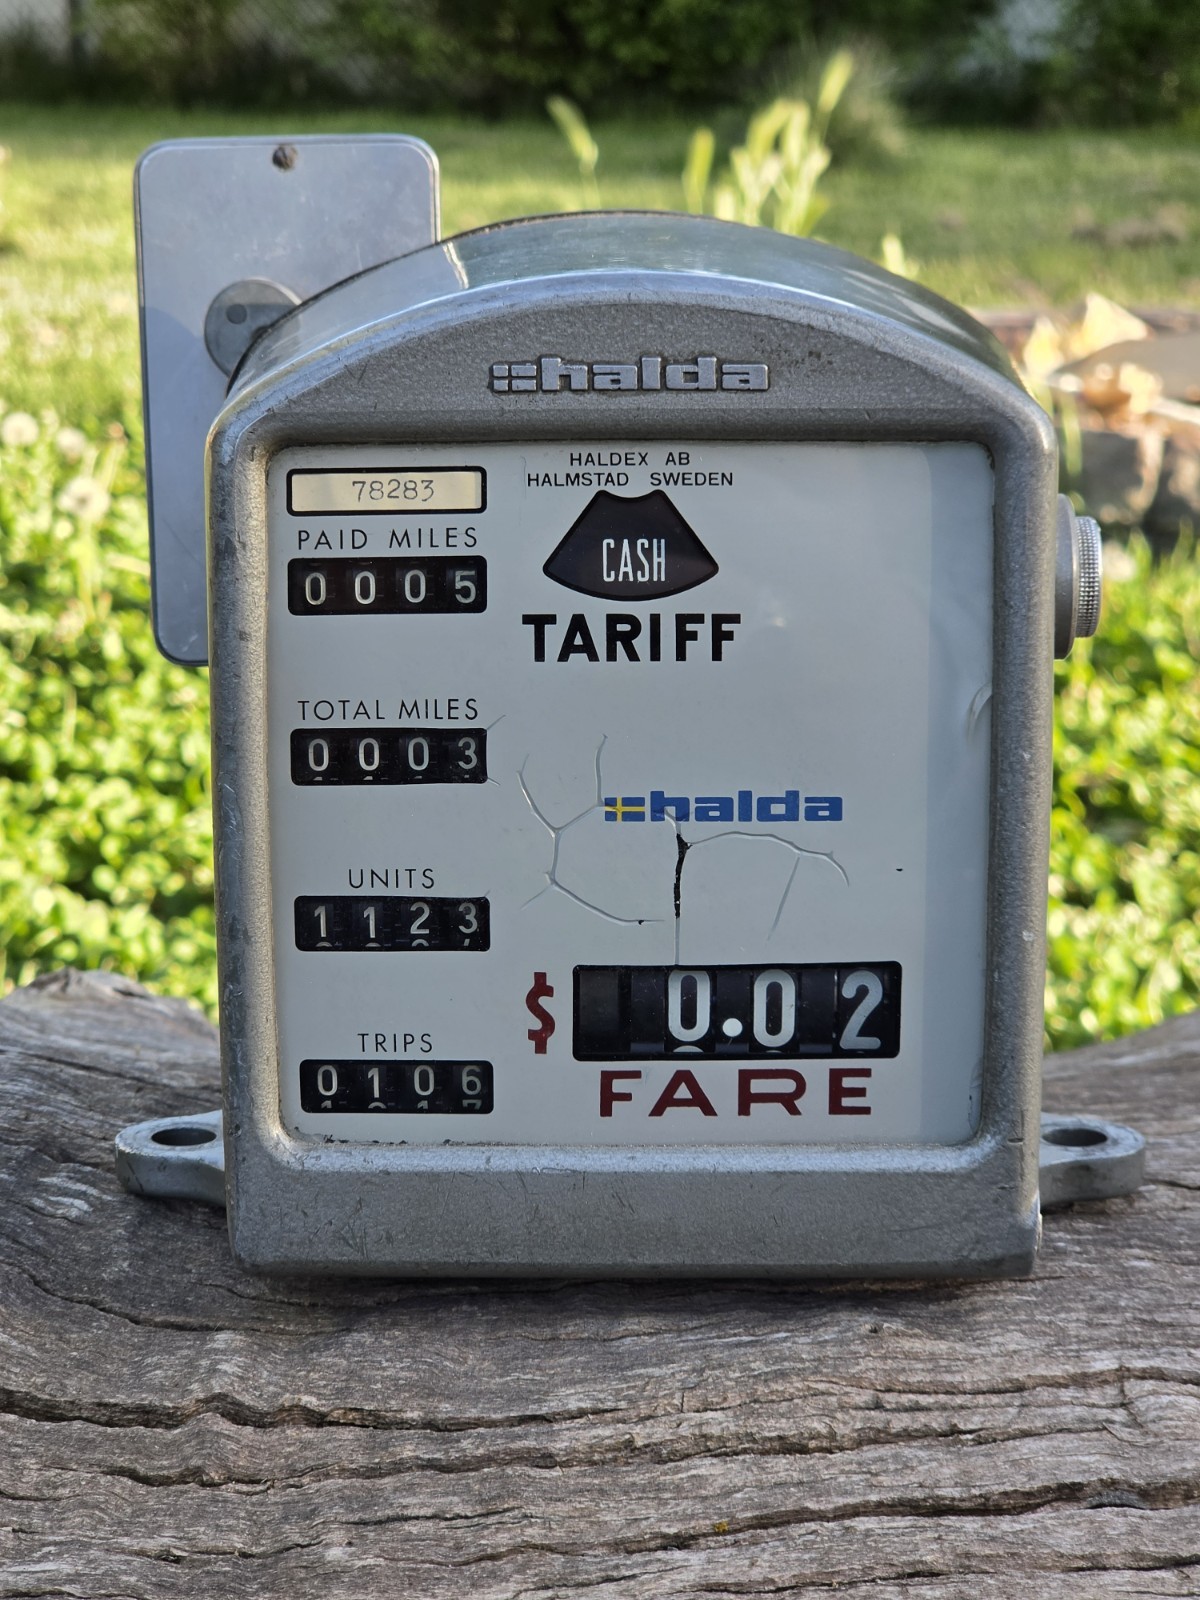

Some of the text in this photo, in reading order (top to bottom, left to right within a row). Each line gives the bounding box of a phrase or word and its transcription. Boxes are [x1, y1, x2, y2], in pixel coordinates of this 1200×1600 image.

[541, 356, 769, 391] halda
[569, 452, 691, 467] HALDEX AB
[352, 479, 435, 502] 78283
[527, 471, 734, 487] HALMSTAD SWEDEN
[297, 527, 478, 550] PAID MILES
[602, 538, 666, 582] CASH
[522, 613, 742, 662] TARIFF
[297, 698, 479, 721] TOTAL MILES
[650, 790, 843, 822] halda
[348, 868, 435, 889] UNITS
[524, 971, 556, 1054] $
[357, 1032, 433, 1053] TRIPS
[599, 1068, 873, 1118] FARE
